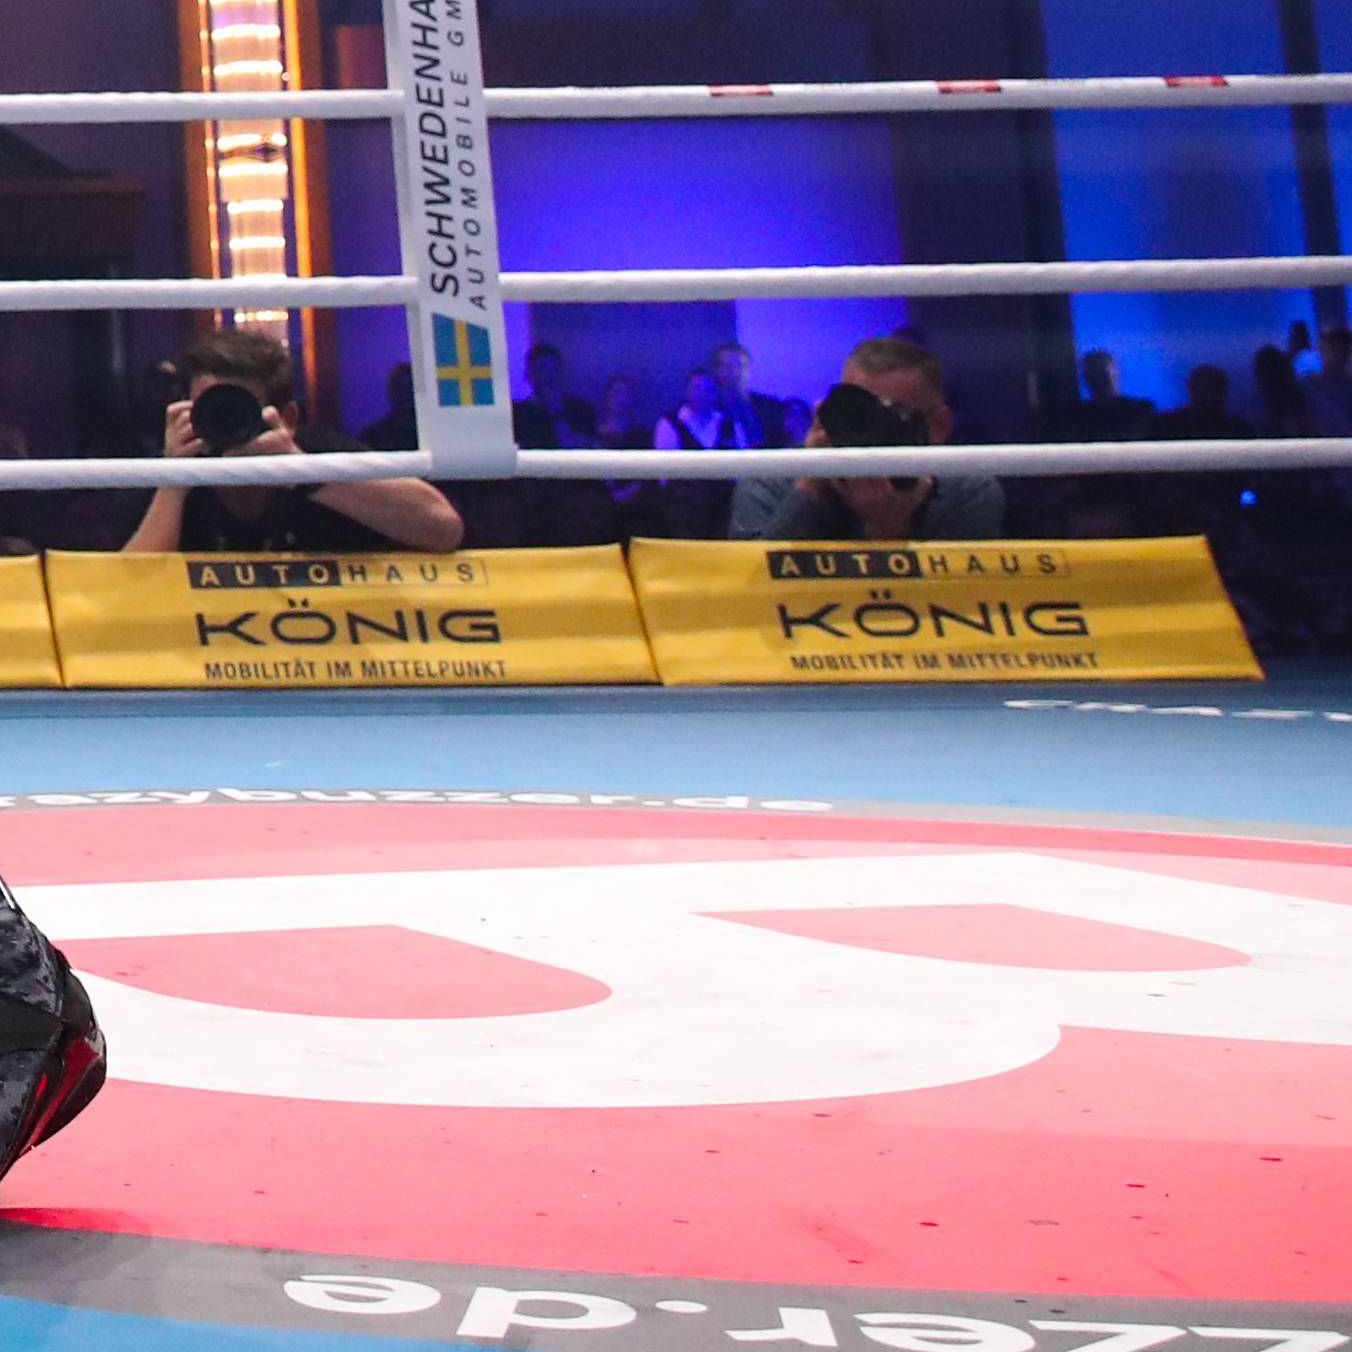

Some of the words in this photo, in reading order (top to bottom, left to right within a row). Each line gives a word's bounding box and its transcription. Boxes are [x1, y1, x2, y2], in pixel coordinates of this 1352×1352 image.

[450, 71, 488, 311] AUTOMOBILE
[197, 598, 502, 647] KÖNIG
[777, 588, 1089, 639] KÖNIG
[204, 657, 318, 681] MOBILITÄT
[326, 659, 353, 680] IM
[360, 658, 507, 680] MITTELPUNKT
[790, 651, 906, 671] MOBILITÄT
[948, 652, 1099, 670] MITTELPUNKT
